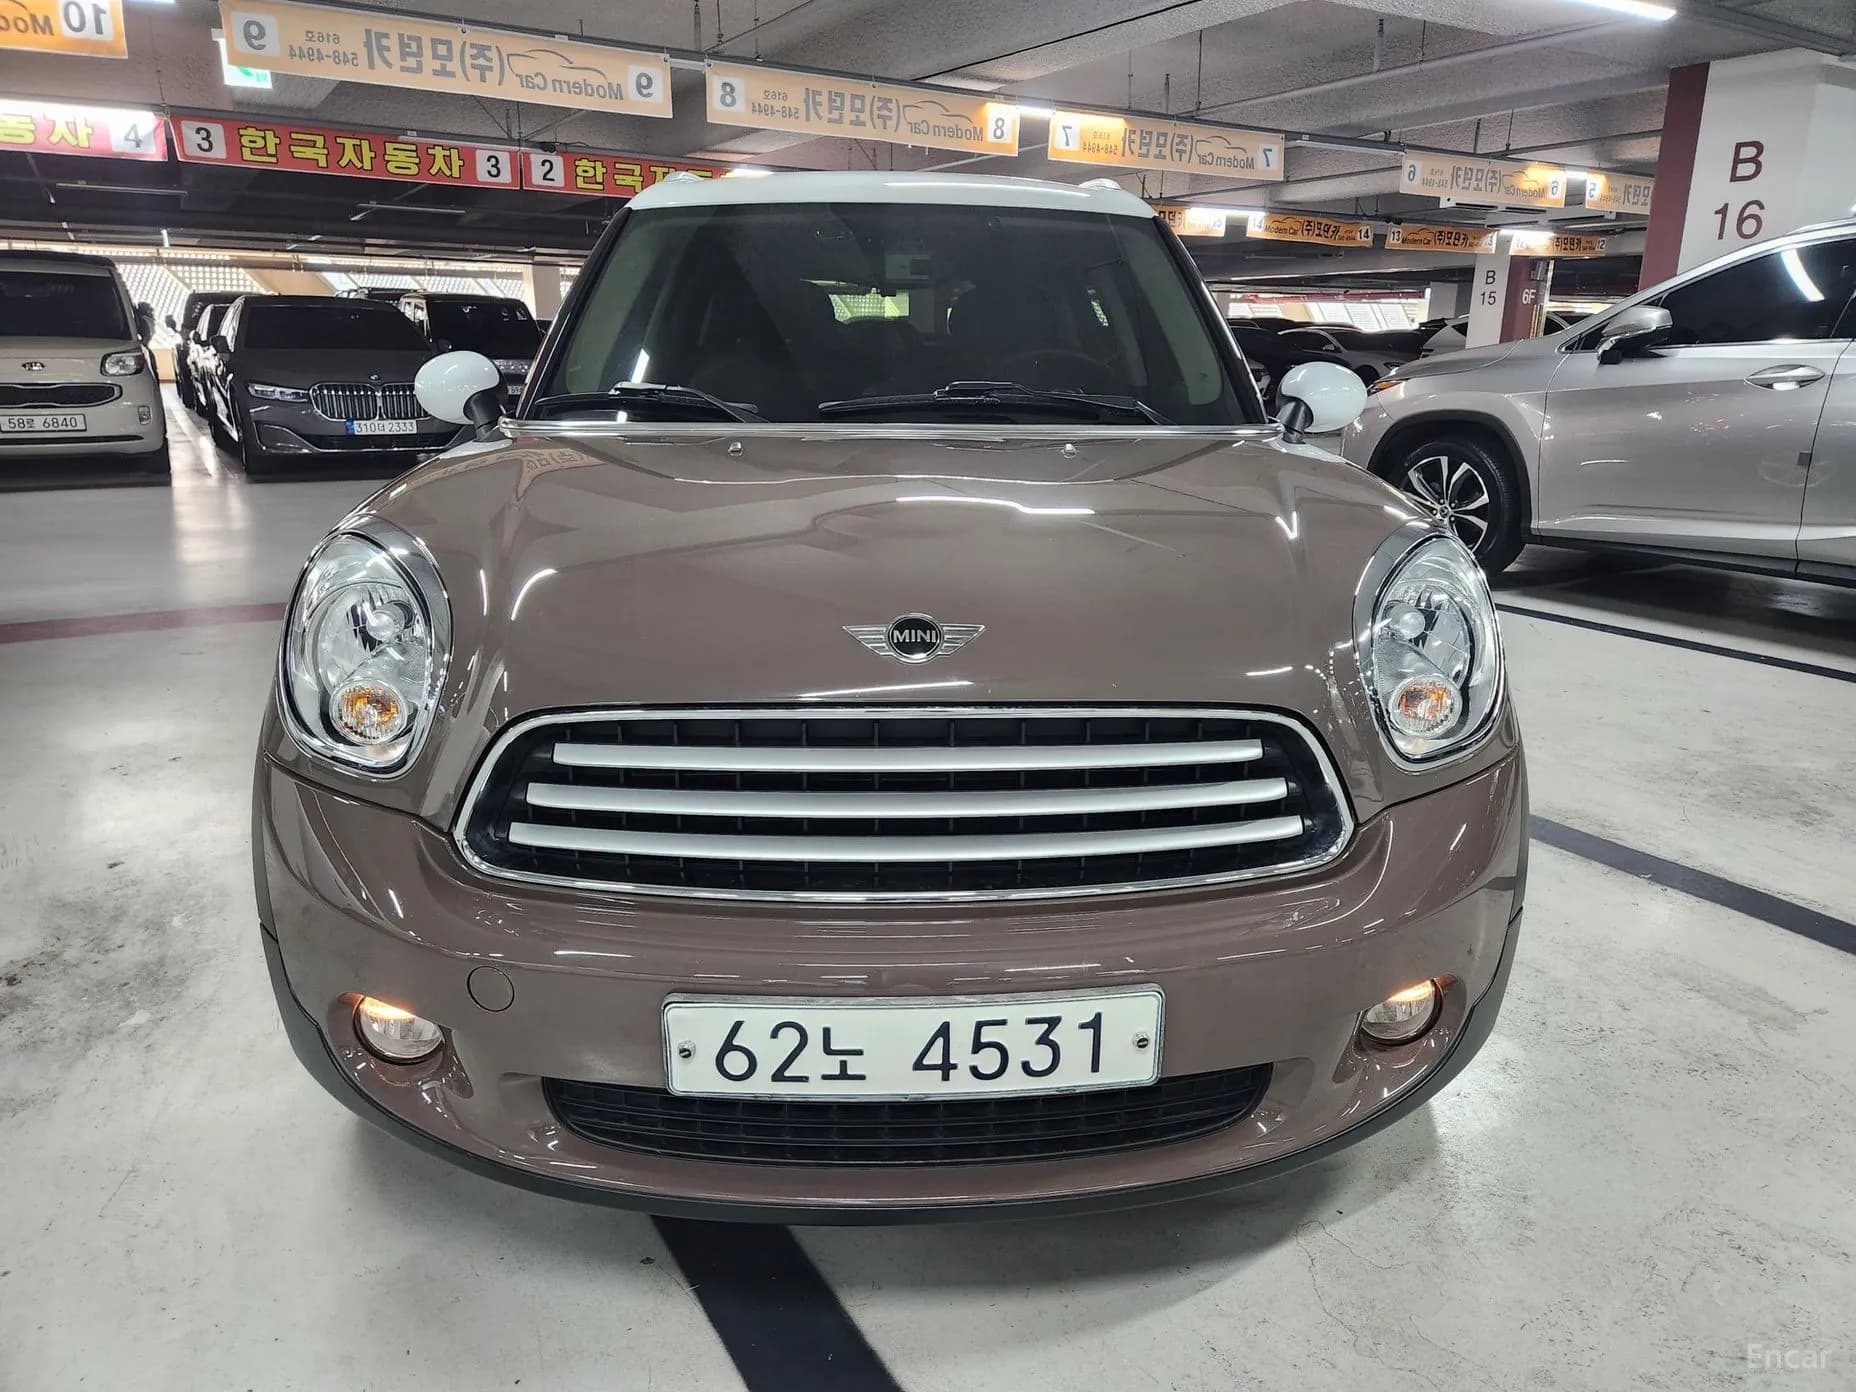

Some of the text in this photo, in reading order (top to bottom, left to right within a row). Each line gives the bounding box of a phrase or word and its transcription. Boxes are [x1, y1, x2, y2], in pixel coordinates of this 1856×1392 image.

[124, 123, 143, 149] 4
[196, 127, 214, 153] 3
[238, 127, 464, 179] 한국자동차
[1729, 140, 1765, 183] B
[486, 155, 502, 179] 3
[540, 158, 556, 182] 2
[1714, 199, 1766, 240] 16
[1358, 228, 1370, 240] 14
[1391, 230, 1401, 242] 13
[1596, 239, 1606, 250] 12
[1485, 270, 1496, 285] B
[1480, 291, 1497, 306] 15
[1522, 288, 1537, 305] 6F
[42, 416, 78, 429] 6840
[388, 422, 414, 433] 2333
[893, 629, 937, 643] MINI
[714, 1011, 1104, 1083] 62노 4531
